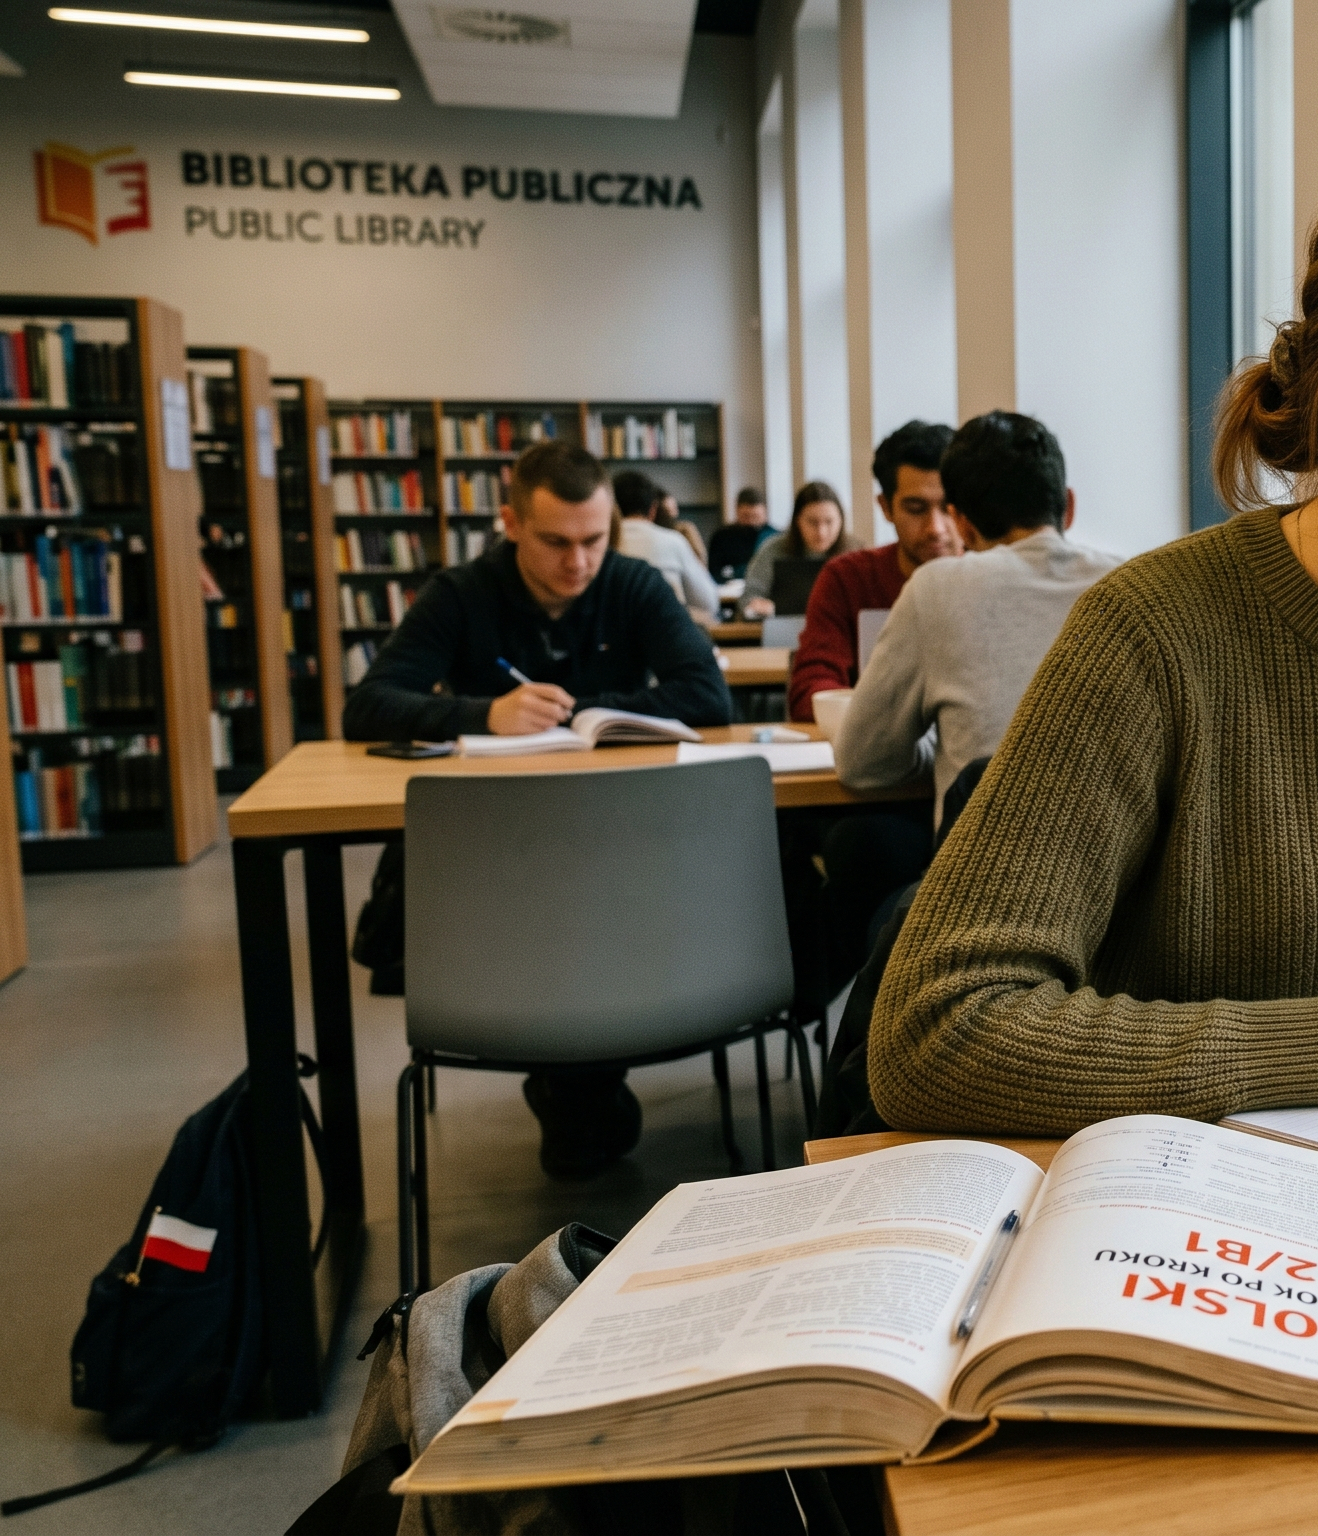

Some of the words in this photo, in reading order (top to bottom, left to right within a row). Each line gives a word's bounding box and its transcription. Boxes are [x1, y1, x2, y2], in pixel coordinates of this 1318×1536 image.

[181, 151, 450, 198] BIBLIOTEKA
[462, 167, 703, 211] PUBLICZNA
[185, 206, 323, 243] PUBLIC
[336, 210, 485, 249] LIBRARY
[1094, 1250, 1210, 1278] KROKU
[1221, 1272, 1263, 1291] PO
